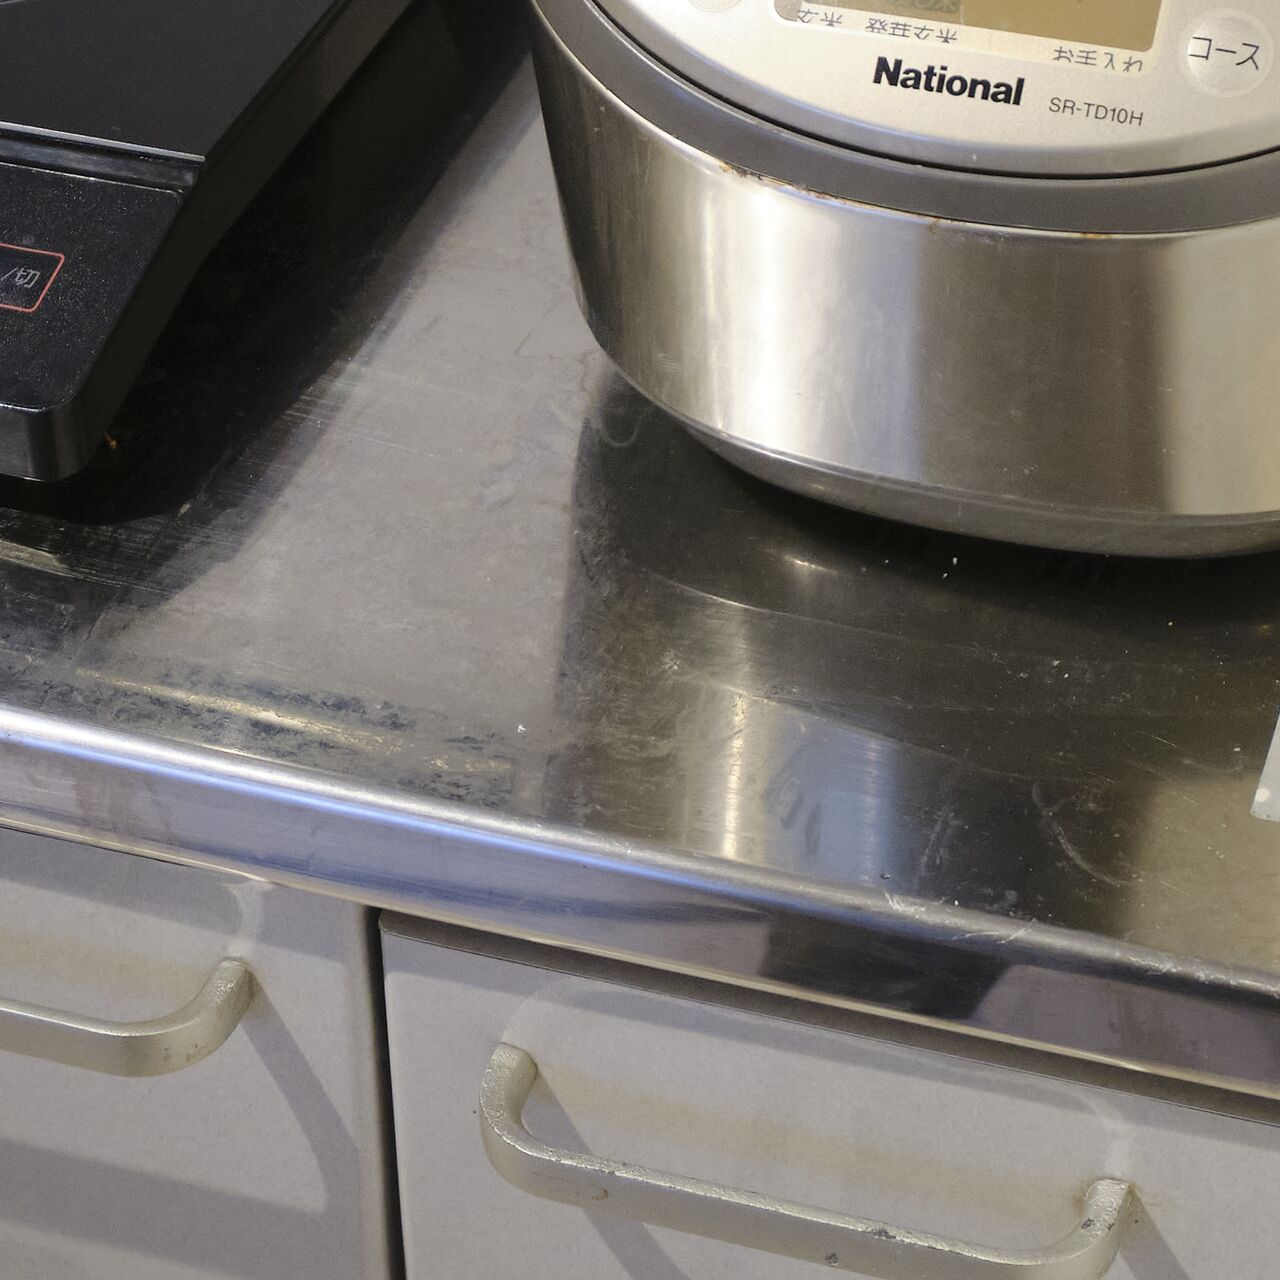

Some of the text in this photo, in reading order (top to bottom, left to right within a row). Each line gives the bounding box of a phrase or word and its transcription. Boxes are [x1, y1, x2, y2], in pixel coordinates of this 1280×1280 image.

[1188, 35, 1261, 71] コース
[872, 55, 1025, 106] National
[1048, 97, 1143, 126] SR-TD10H
